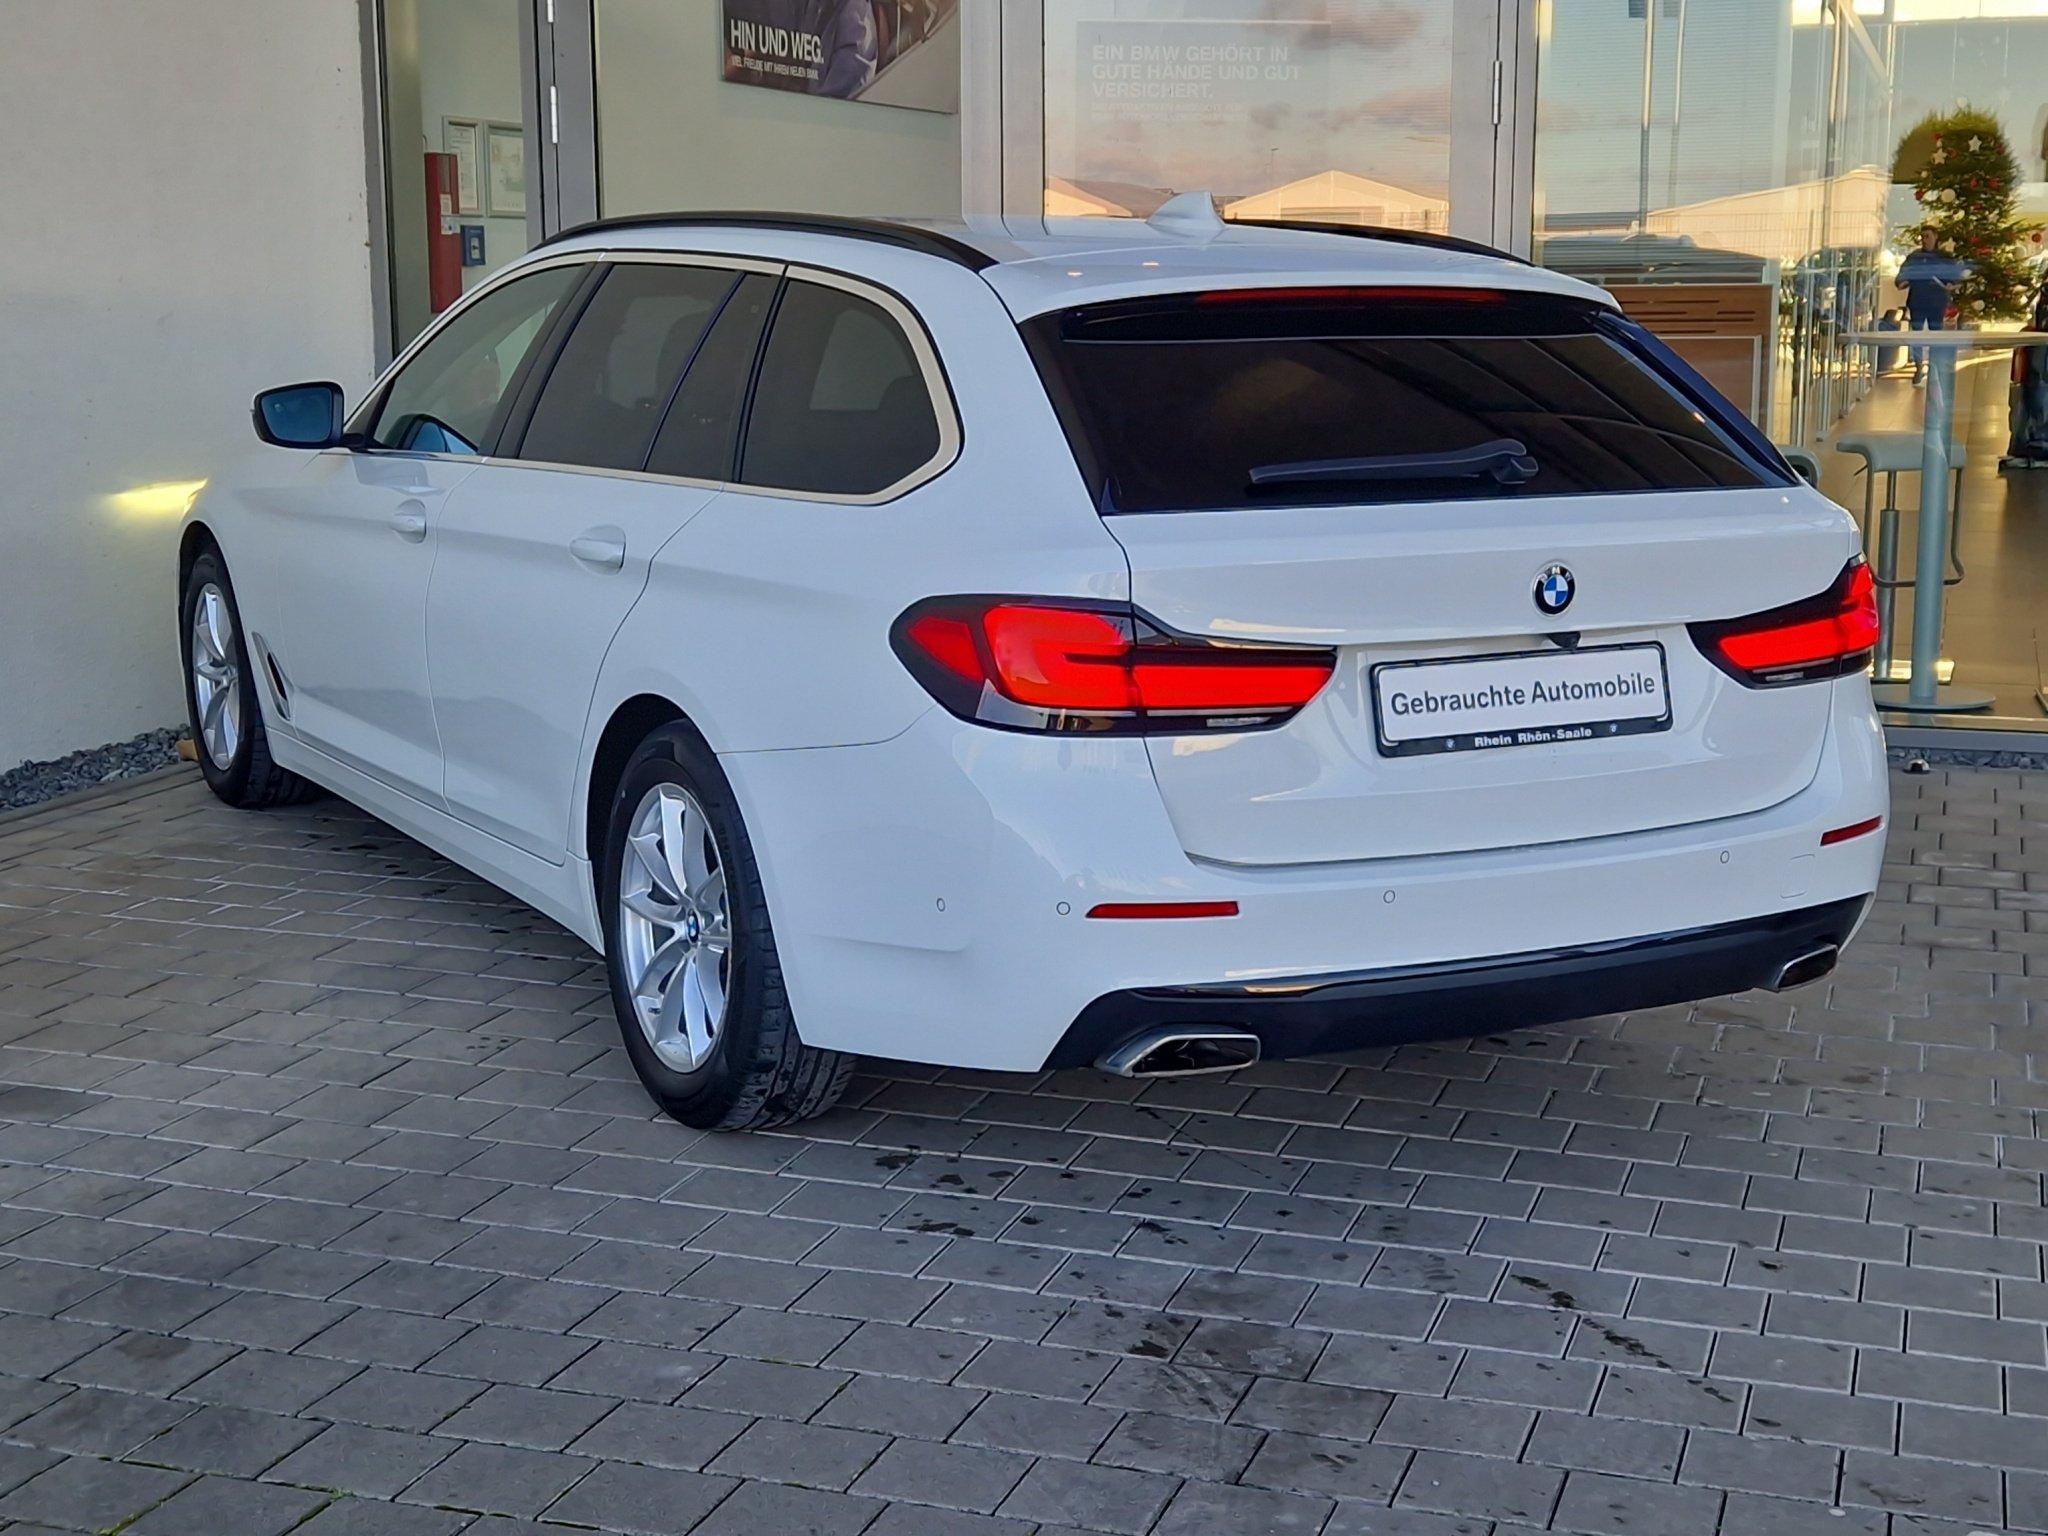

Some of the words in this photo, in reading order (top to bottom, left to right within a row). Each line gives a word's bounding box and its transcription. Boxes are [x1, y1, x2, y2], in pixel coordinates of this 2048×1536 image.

[731, 18, 755, 52] HIN
[759, 24, 788, 57] UND
[791, 31, 824, 64] WEG.
[1091, 44, 1124, 61] EIN
[1130, 45, 1179, 61] BMW
[1186, 43, 1265, 61] GEHÖRT
[1271, 46, 1288, 61] IN
[1092, 63, 1142, 80] GUTE
[1219, 64, 1258, 80] UND
[1264, 64, 1302, 81] GUT
[1092, 82, 1213, 98] VERSICHERT.
[1391, 685, 1526, 716] Gebrauchte
[1531, 673, 1656, 704] Automobile
[1474, 734, 1512, 747] Rhein
